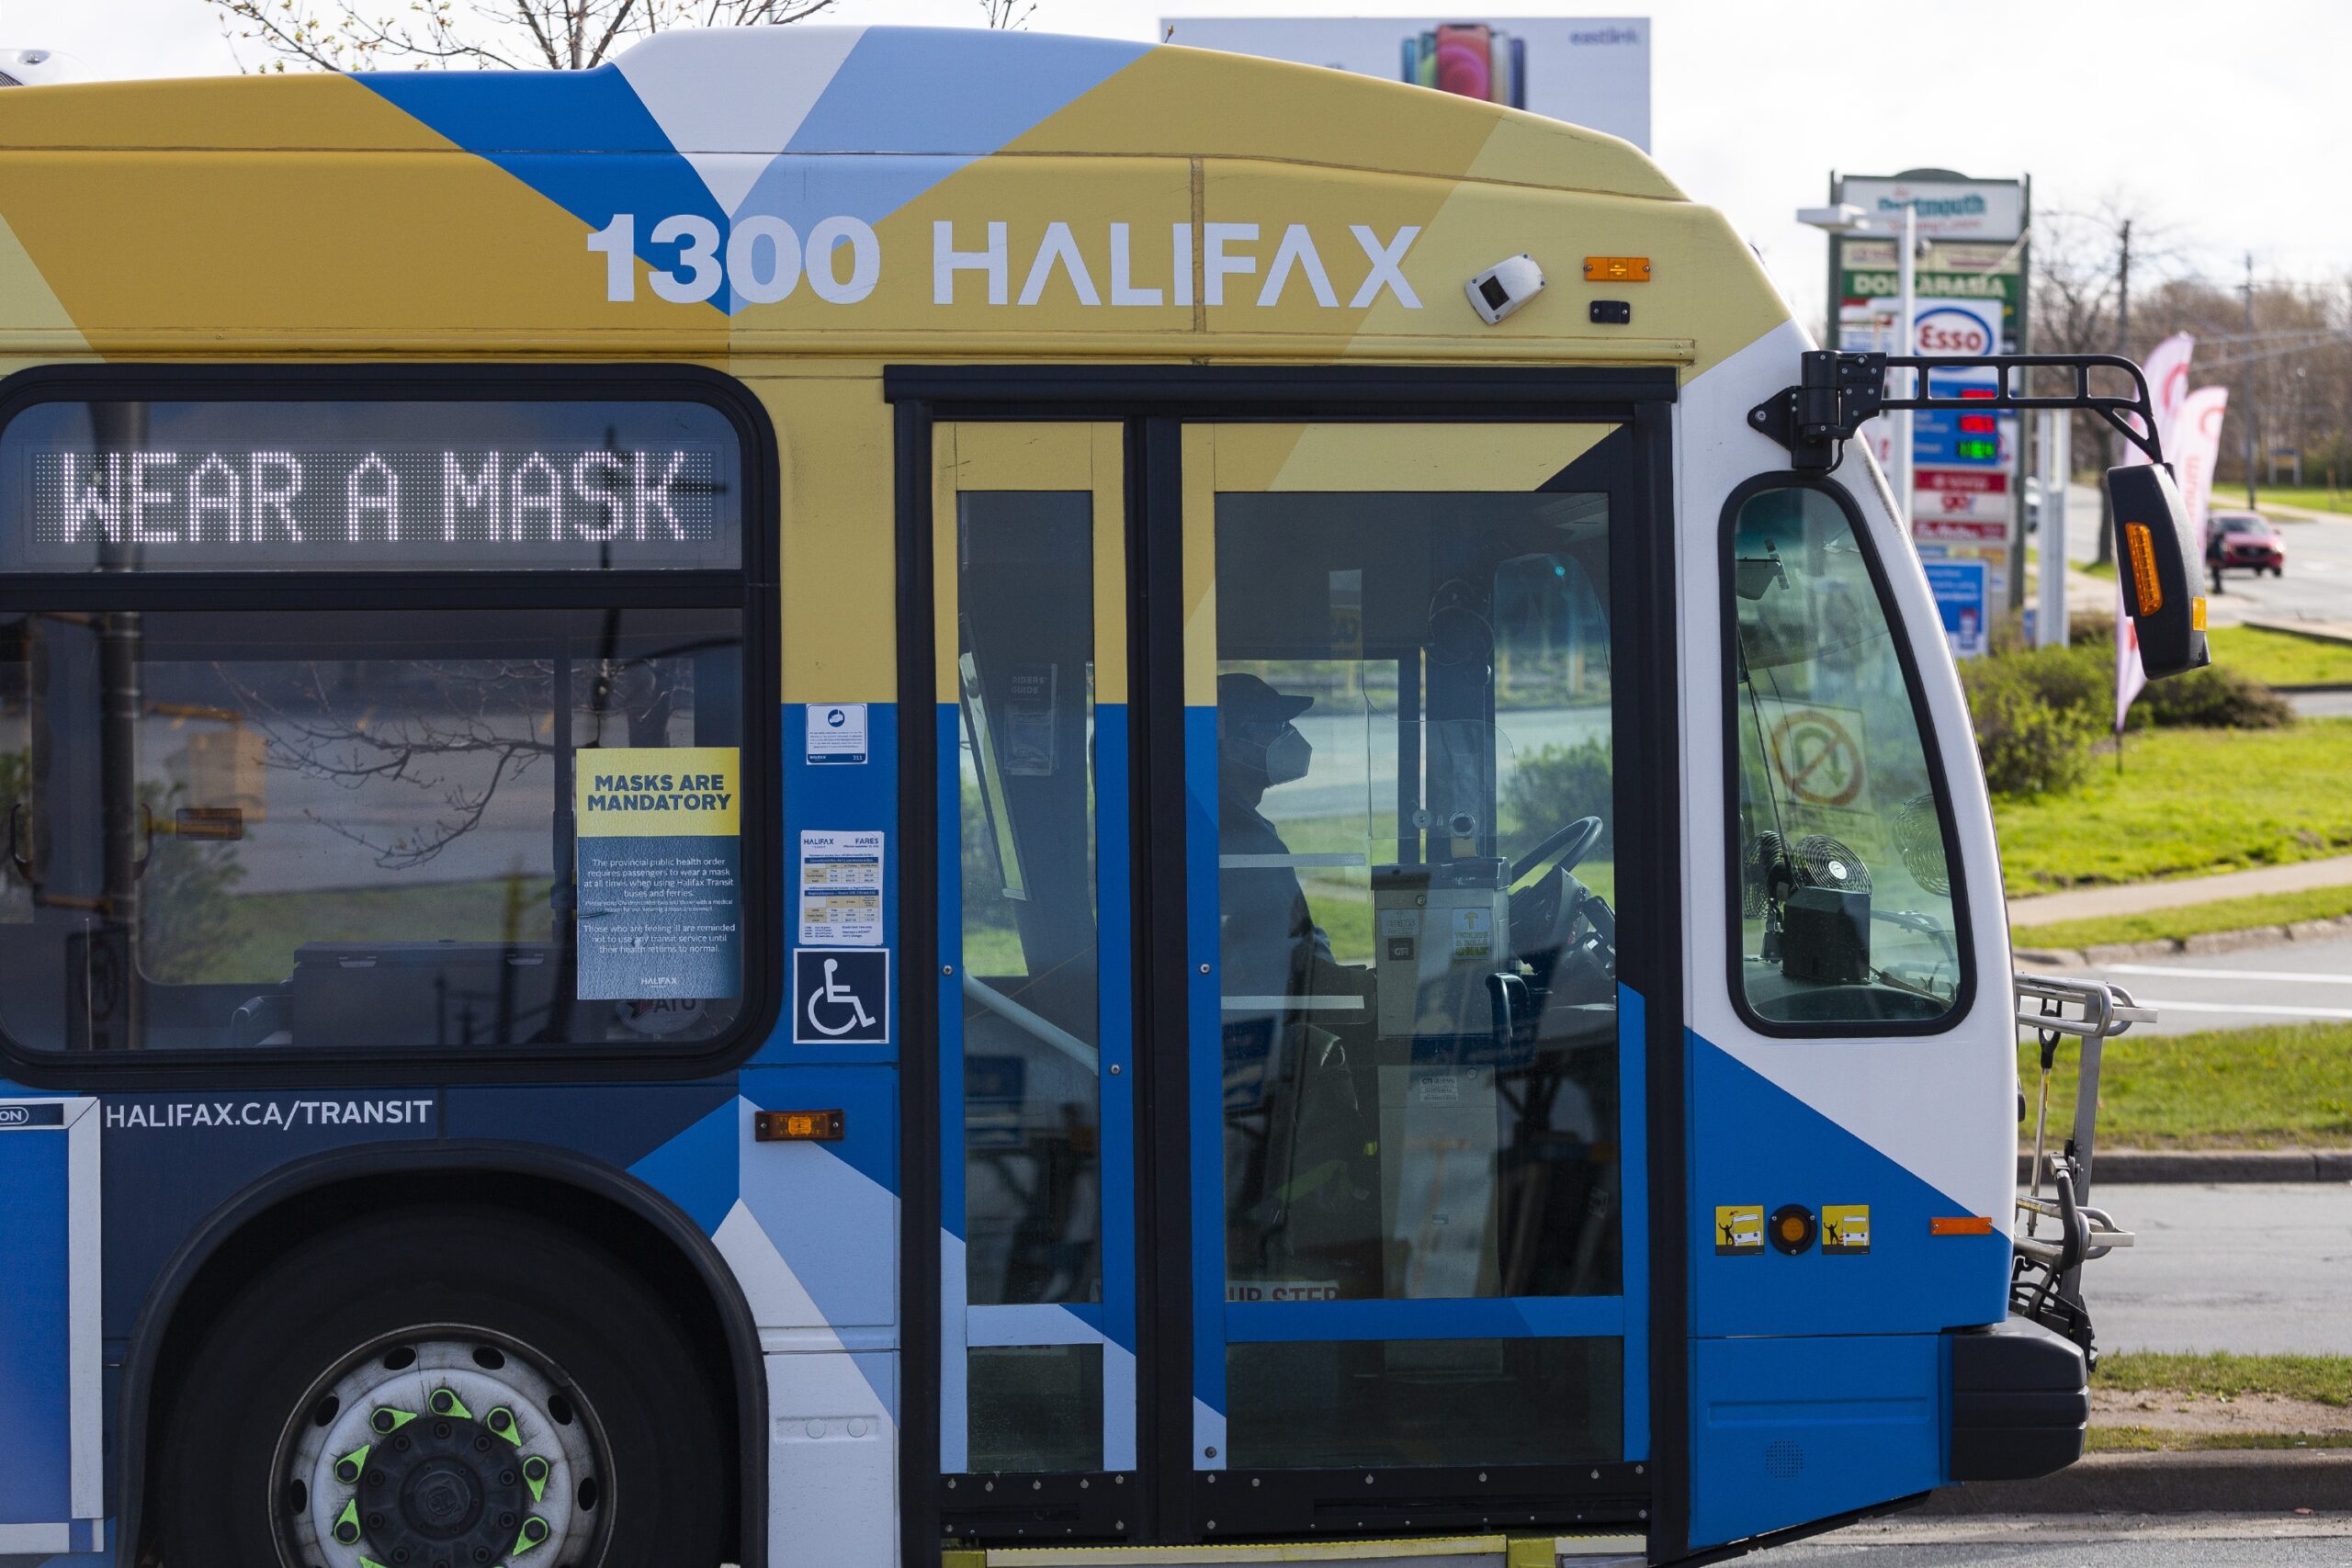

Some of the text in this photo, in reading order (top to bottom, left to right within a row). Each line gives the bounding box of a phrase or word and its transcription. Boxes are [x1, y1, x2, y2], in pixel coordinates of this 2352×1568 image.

[587, 214, 880, 304] 1300
[933, 220, 1423, 310] HALIFAX
[1854, 274, 2006, 297] DOARAMA
[1919, 323, 1982, 351] Esso
[63, 451, 686, 543] WEAR A MASK
[594, 774, 724, 792] MASKS ARE
[587, 794, 731, 811] MANDATORY
[610, 858, 649, 867] provincial
[650, 858, 674, 867] public
[588, 870, 621, 878] requires
[622, 869, 668, 878] passengers
[605, 879, 628, 887] times
[629, 879, 652, 887] when
[653, 879, 675, 888] using
[677, 878, 705, 886] Halifax
[707, 878, 734, 886] Transit
[624, 889, 648, 897] buses
[583, 924, 608, 932] Those
[610, 924, 628, 932] who
[645, 924, 672, 934] feeling
[697, 923, 736, 931] reminded
[678, 934, 707, 942] service
[599, 945, 617, 953] their
[620, 945, 645, 953] health
[640, 976, 677, 986] HALIFAX
[106, 1100, 433, 1131] HALIFAX.CA/TRANSIT
